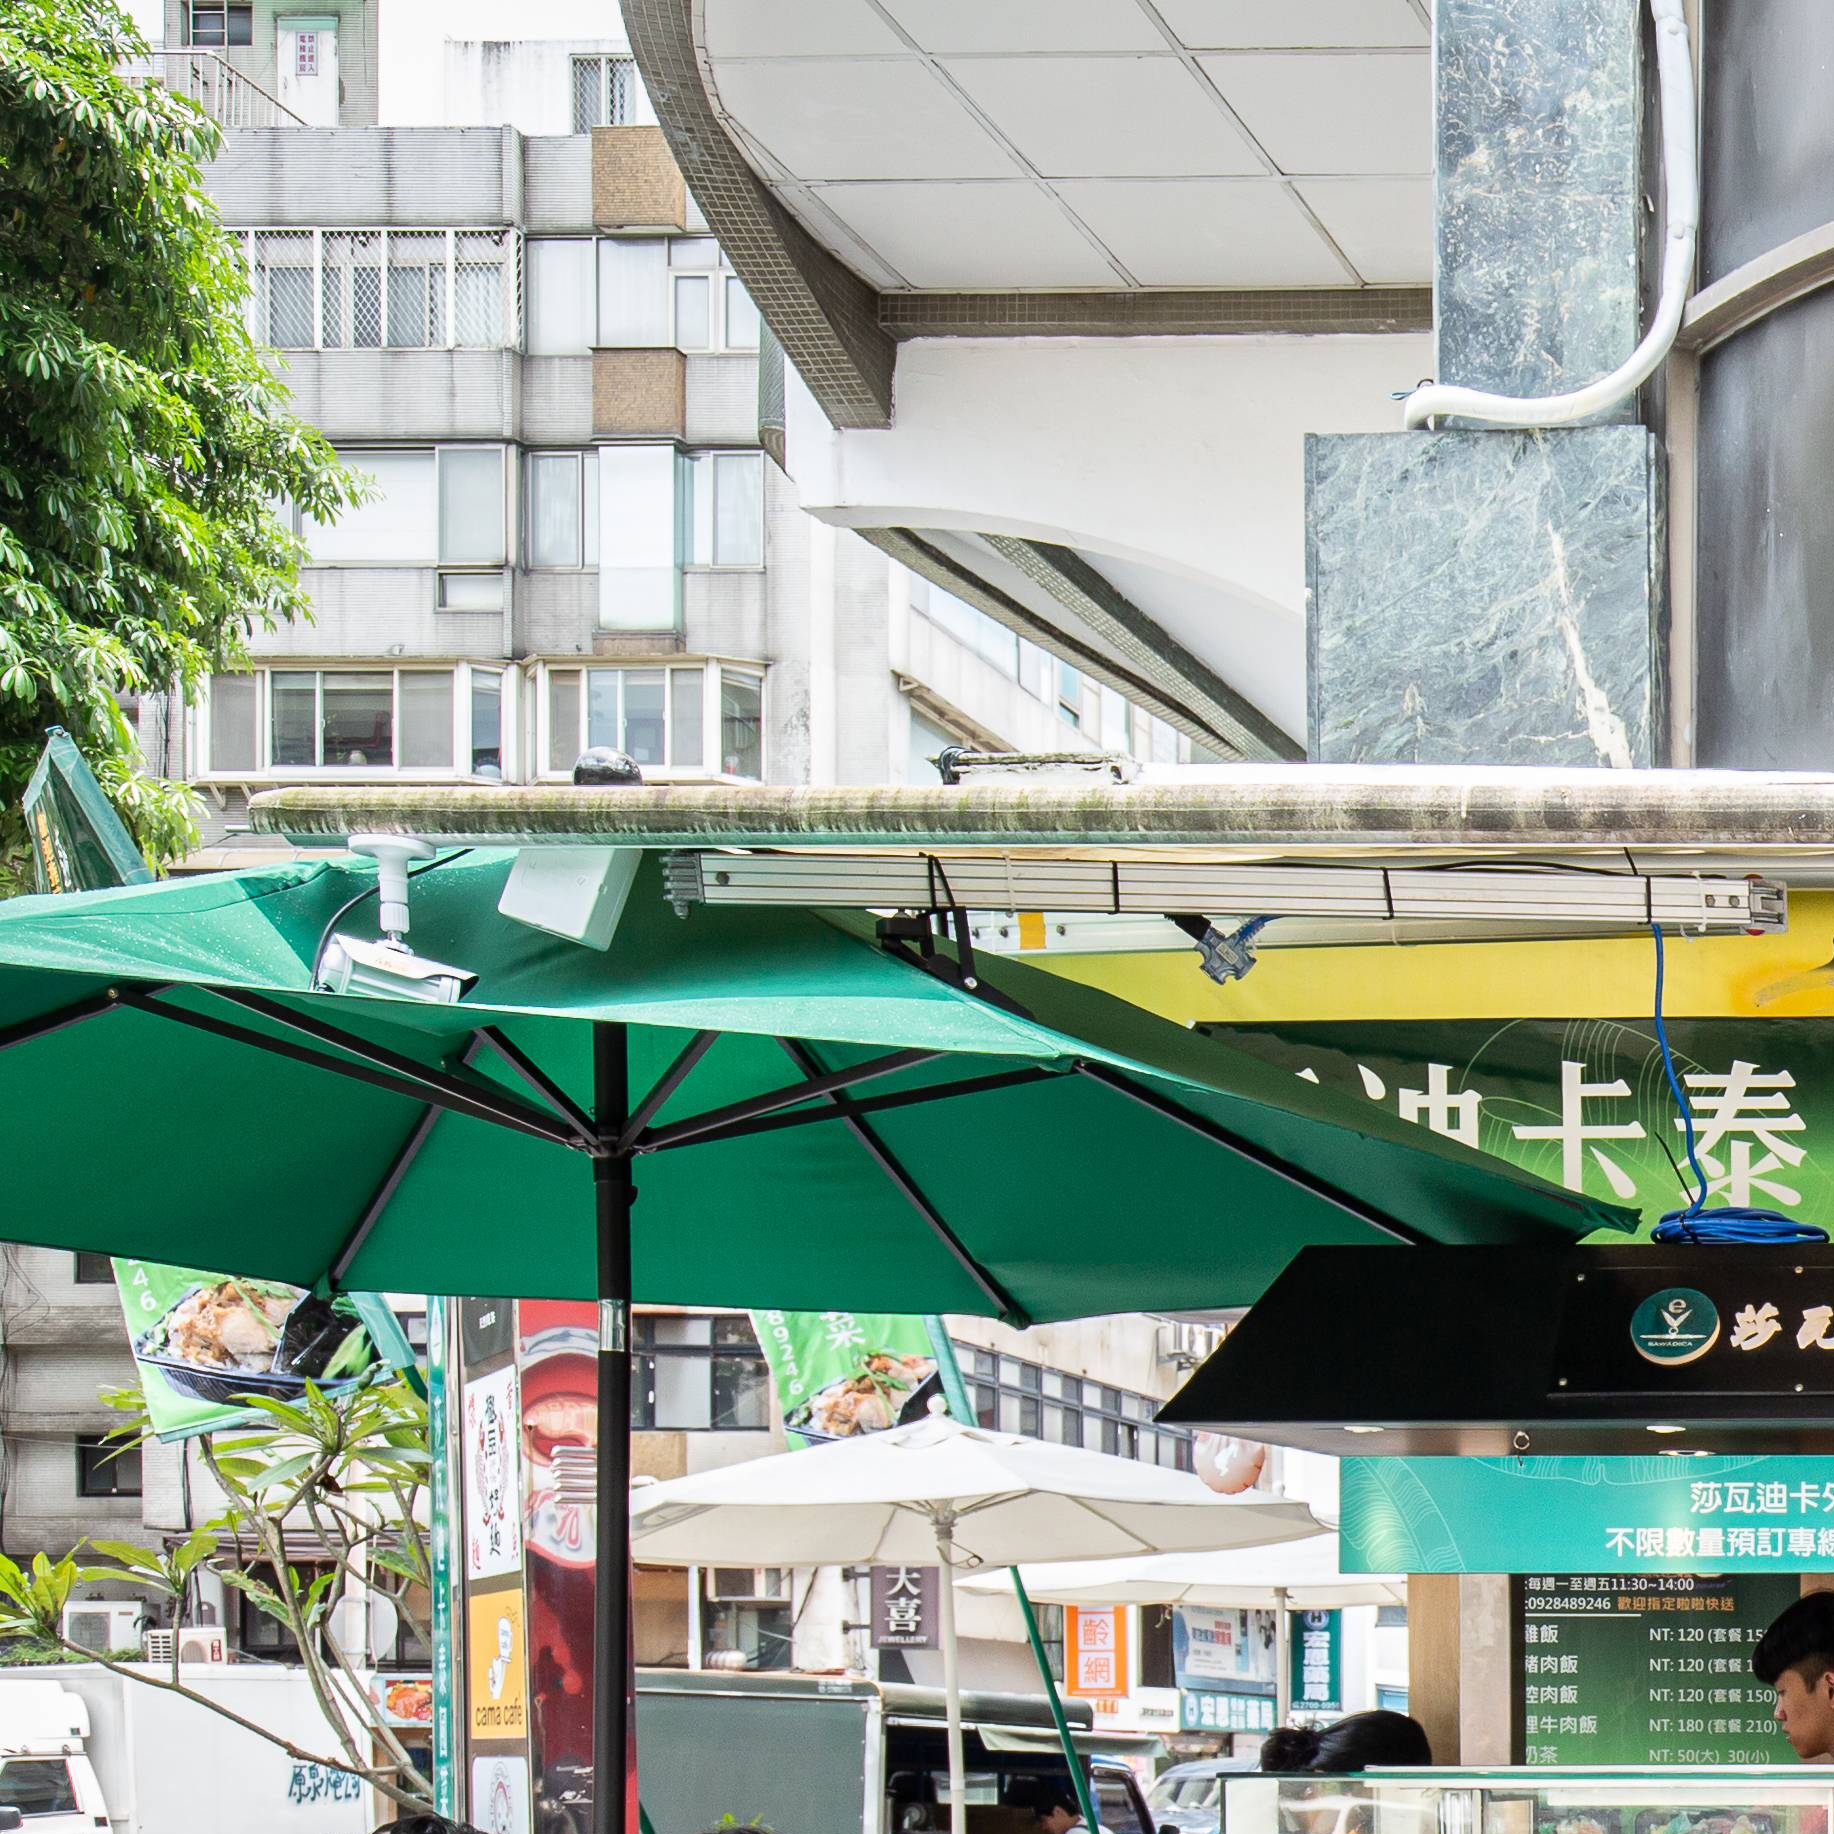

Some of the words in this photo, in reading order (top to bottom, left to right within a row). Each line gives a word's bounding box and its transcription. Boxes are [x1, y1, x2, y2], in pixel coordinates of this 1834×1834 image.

[886, 1566, 922, 1633] 大喜
[1617, 1596, 1735, 1611] 歡迎指定啦啦快送
[1649, 1628, 1673, 1642] NT:
[1677, 1628, 1703, 1642] 120
[1649, 1659, 1673, 1672] NT:
[1677, 1659, 1703, 1672] 120
[1649, 1689, 1673, 1703] NT:
[1677, 1689, 1703, 1703] 120
[1746, 1689, 1777, 1704] 150)
[475, 1705, 500, 1727] cama
[1649, 1719, 1673, 1733] NT:
[1677, 1719, 1703, 1733] 180
[1746, 1719, 1777, 1734] 210)
